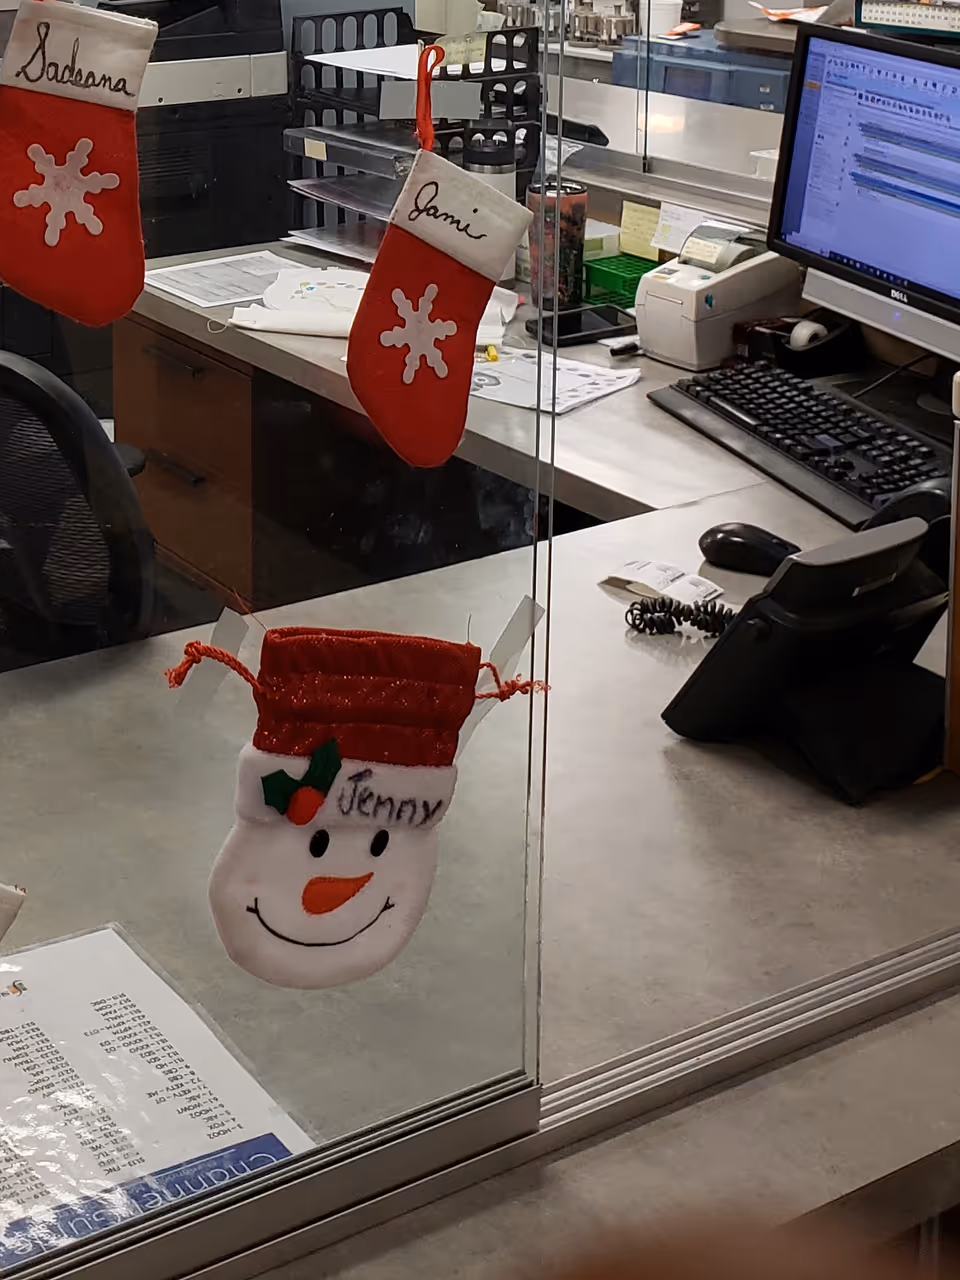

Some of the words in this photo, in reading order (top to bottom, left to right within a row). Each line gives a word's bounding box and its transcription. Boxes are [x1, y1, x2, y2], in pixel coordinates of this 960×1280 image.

[408, 181, 488, 240] Jami
[890, 288, 909, 304] DELL
[337, 768, 444, 827] Jenny
[28, 1083, 55, 1094] BRAVO
[208, 1122, 225, 1130] FOX
